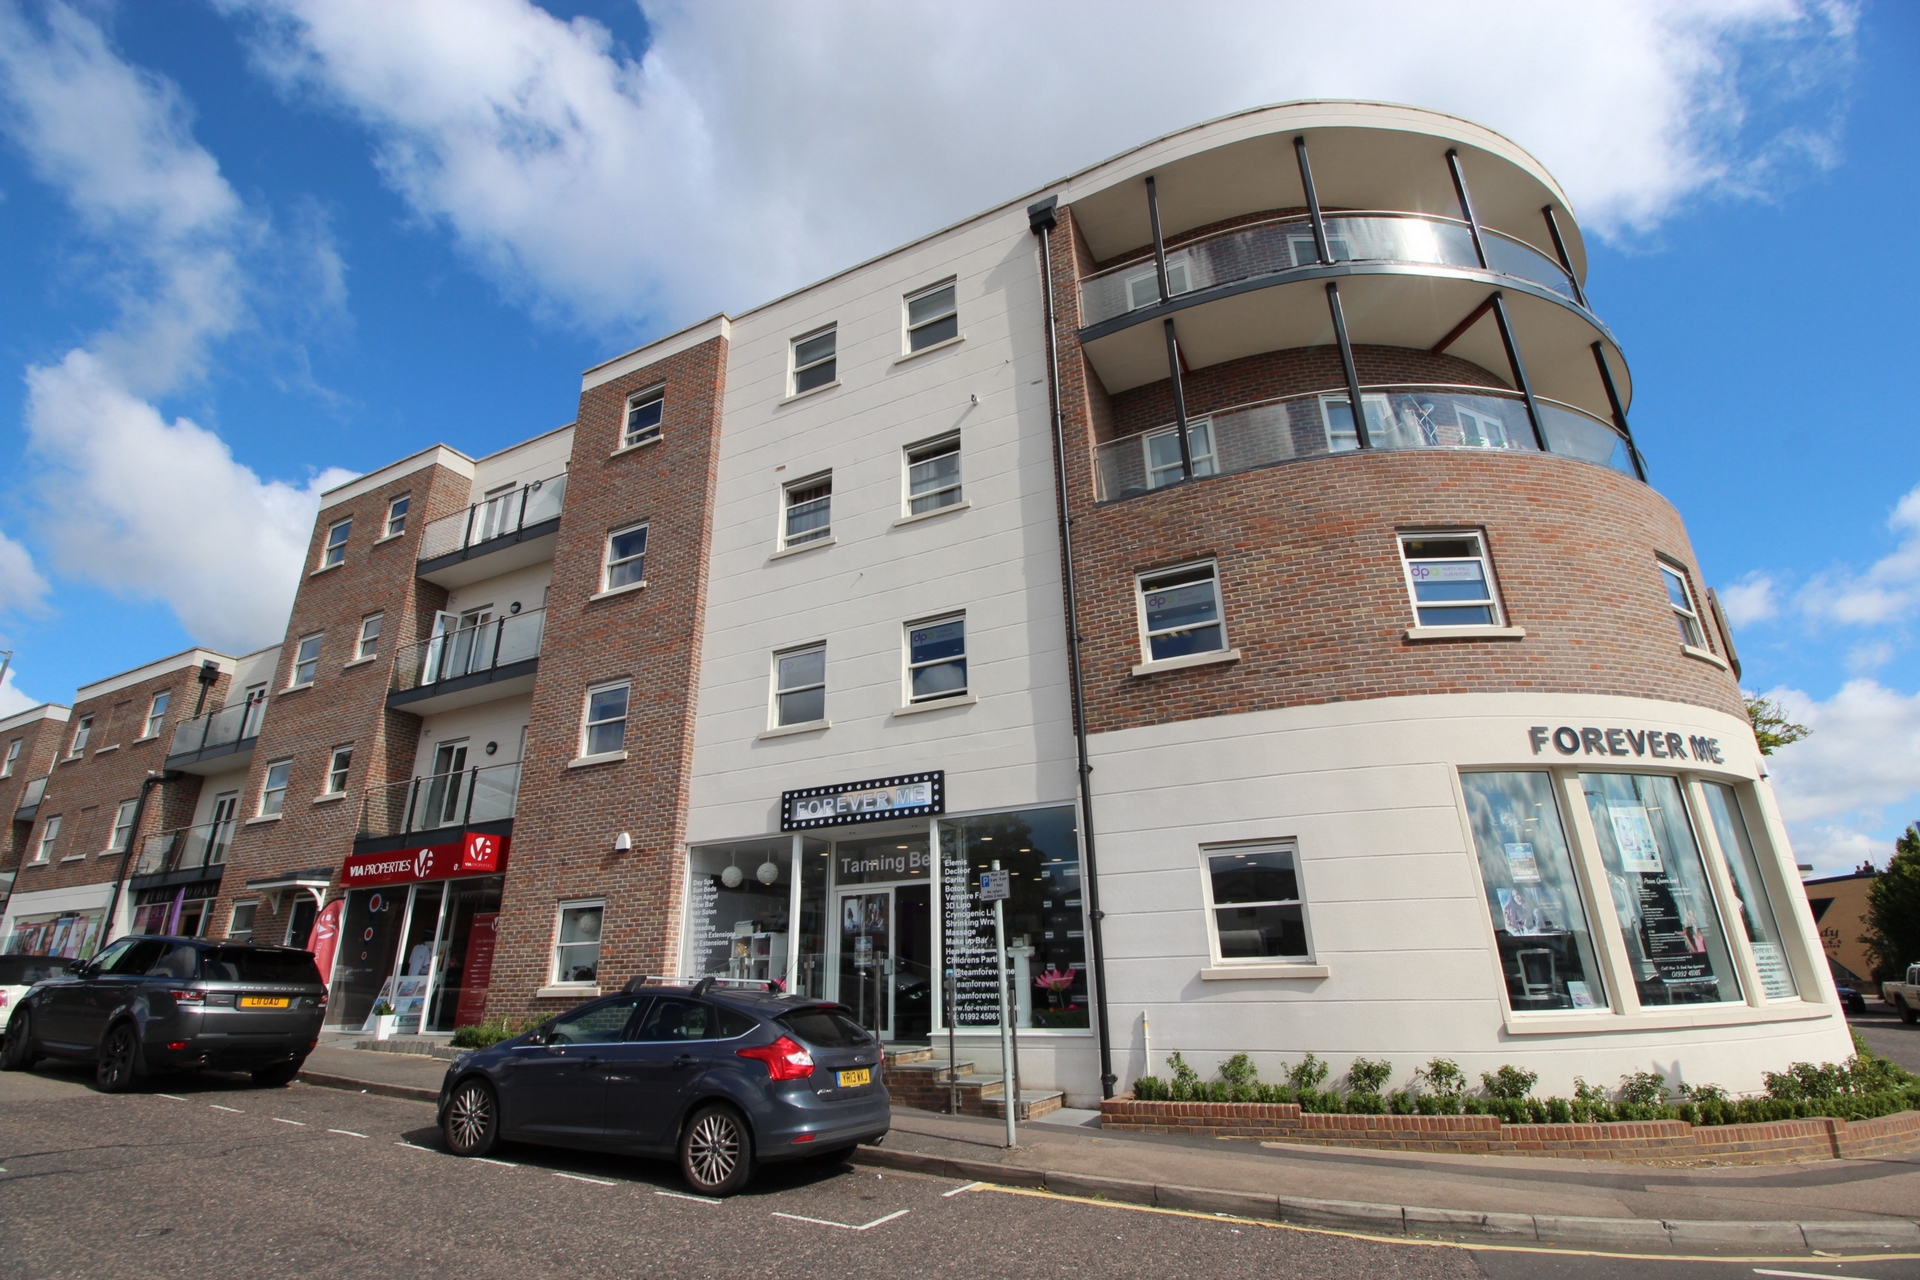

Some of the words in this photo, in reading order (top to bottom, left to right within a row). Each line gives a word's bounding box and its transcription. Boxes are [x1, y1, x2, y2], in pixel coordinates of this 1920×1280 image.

[1411, 565, 1440, 580] dpa
[1527, 726, 1688, 760] FOREVER
[1688, 734, 1724, 764] ME
[796, 790, 889, 818] FOREVER
[895, 785, 926, 806] ME
[841, 854, 905, 874] Tanning
[703, 893, 718, 901] Angel
[946, 910, 985, 919] Crynogenic
[946, 920, 979, 928] Shrinking
[946, 956, 980, 964] Childrens
[955, 968, 1015, 977] @teamforevme
